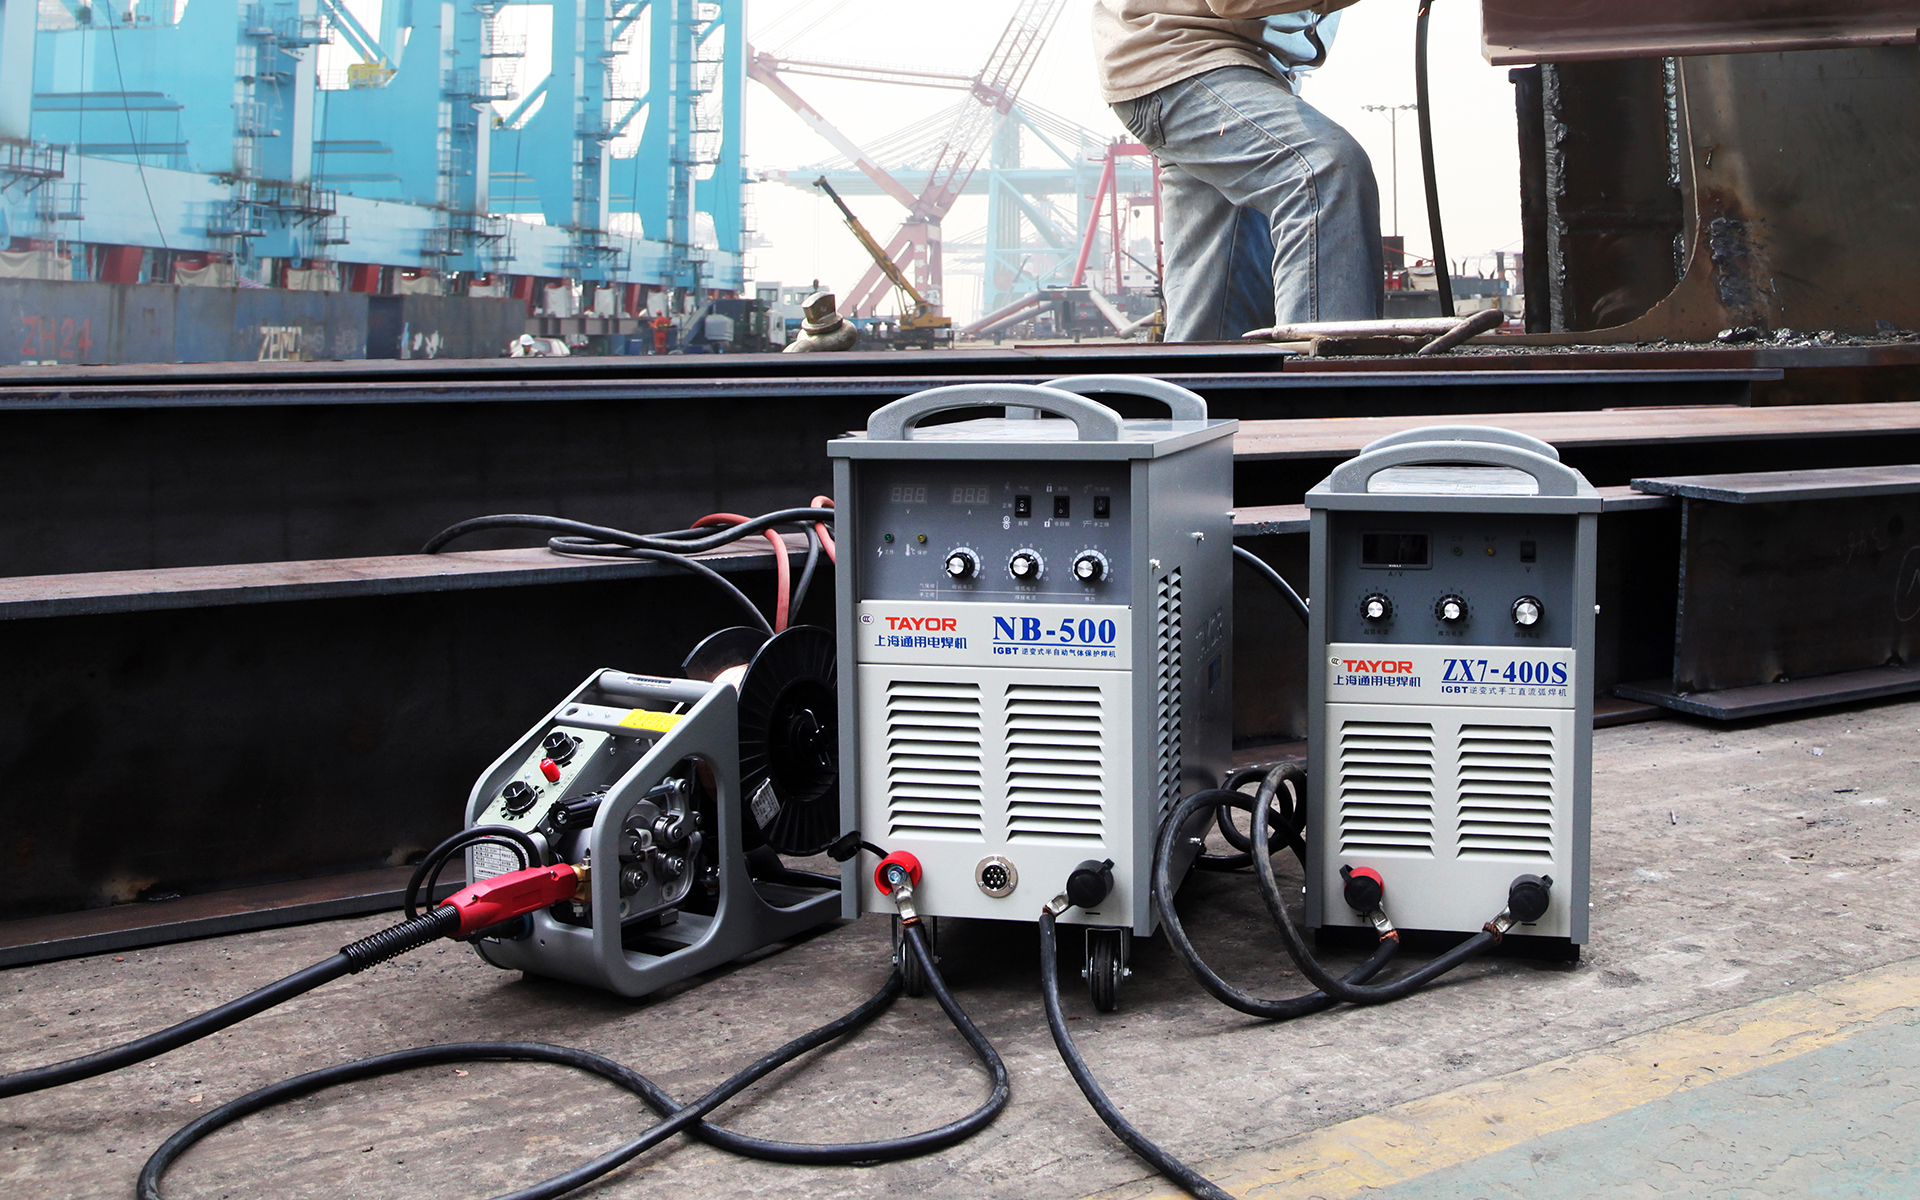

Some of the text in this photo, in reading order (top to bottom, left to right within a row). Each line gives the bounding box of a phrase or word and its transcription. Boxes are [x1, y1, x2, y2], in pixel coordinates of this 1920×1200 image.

[21, 316, 94, 357] ZH24
[885, 617, 957, 632] TAYOR
[993, 616, 1116, 644] NB-500
[874, 635, 967, 650] 上海通用电焊机
[993, 646, 1117, 658] IGBT 逆变式半自动气体保护焊机
[1343, 660, 1413, 674] TAYOR
[1441, 659, 1568, 684] ZX7-400S
[1333, 674, 1421, 687] 上海通用电焊机
[1441, 686, 1567, 697] IGBT 逆变式手工直流弧焊机
